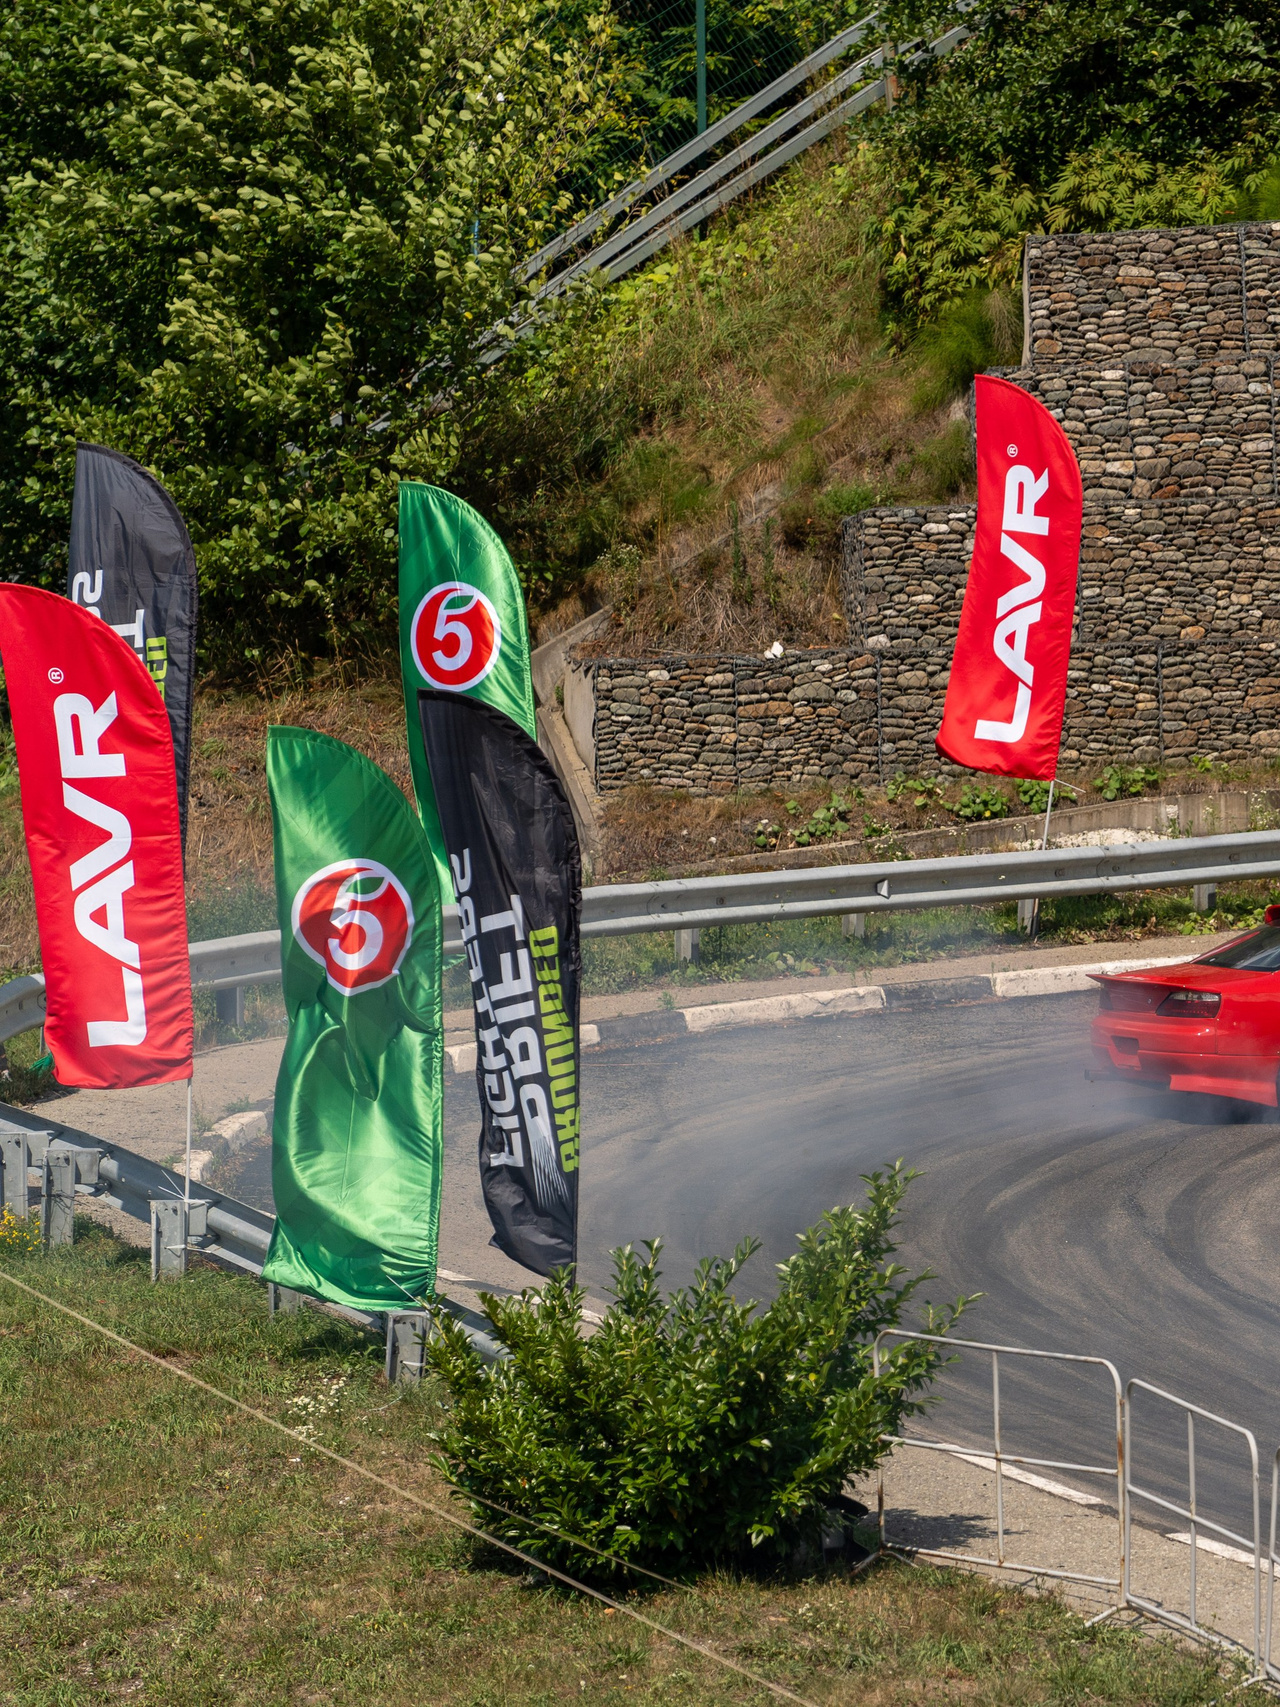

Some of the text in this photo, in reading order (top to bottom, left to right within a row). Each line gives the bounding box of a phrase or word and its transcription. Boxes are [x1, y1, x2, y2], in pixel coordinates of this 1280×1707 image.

[431, 589, 476, 671] 5
[974, 464, 1050, 744] LAVR
[53, 690, 148, 1048] LAVR
[328, 871, 387, 970] 5
